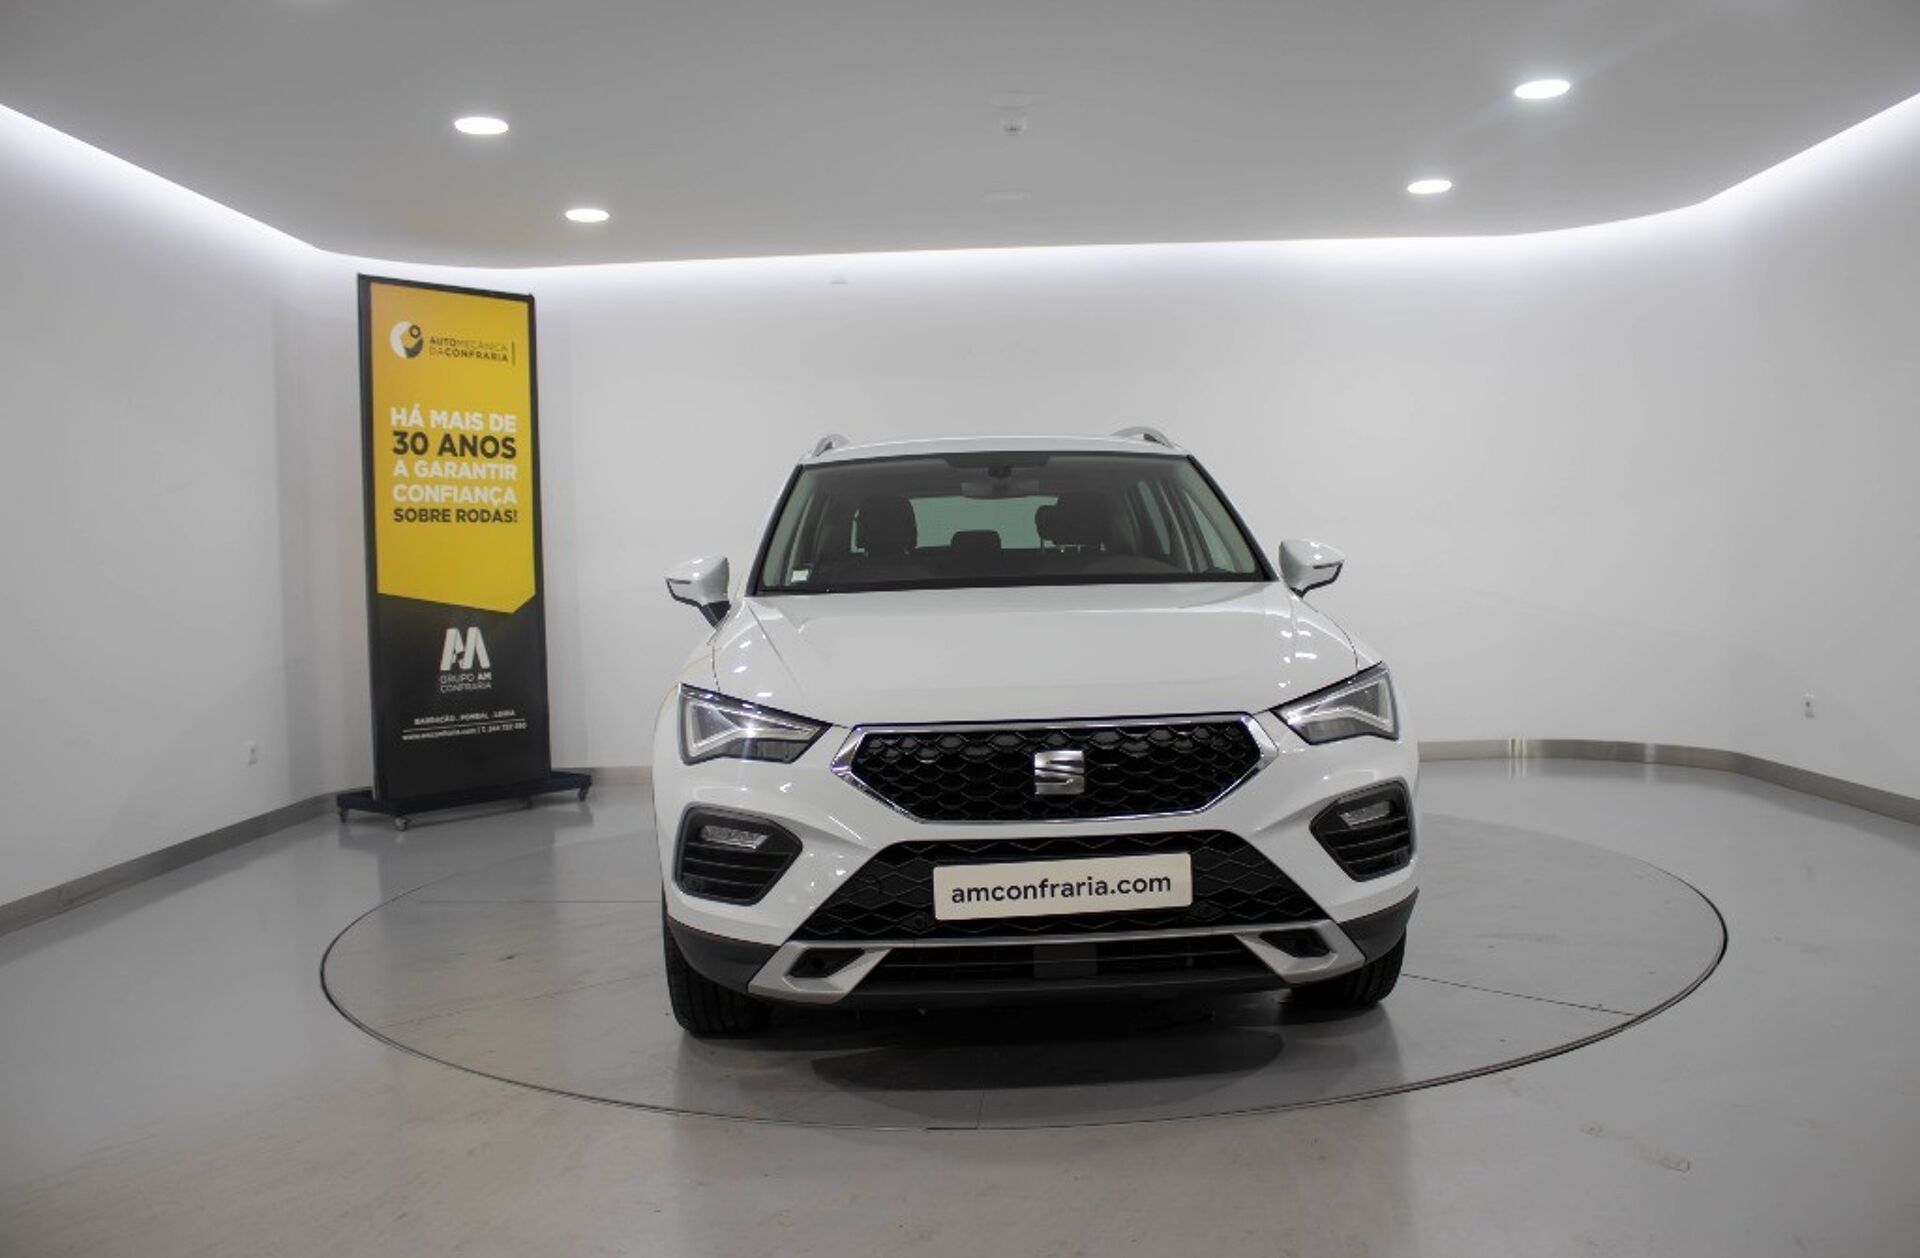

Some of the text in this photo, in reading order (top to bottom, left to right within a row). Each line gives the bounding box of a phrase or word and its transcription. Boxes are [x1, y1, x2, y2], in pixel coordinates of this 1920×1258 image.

[390, 404, 517, 432] HÁ MAIS DE
[392, 431, 517, 459] 30 ANOS
[393, 460, 517, 481] A GARANTIR
[392, 484, 517, 506] CONFIANÇA
[393, 508, 518, 524] SOBRE RODAS!
[477, 672, 492, 681] AM
[951, 875, 1171, 904] amconfraria.com
